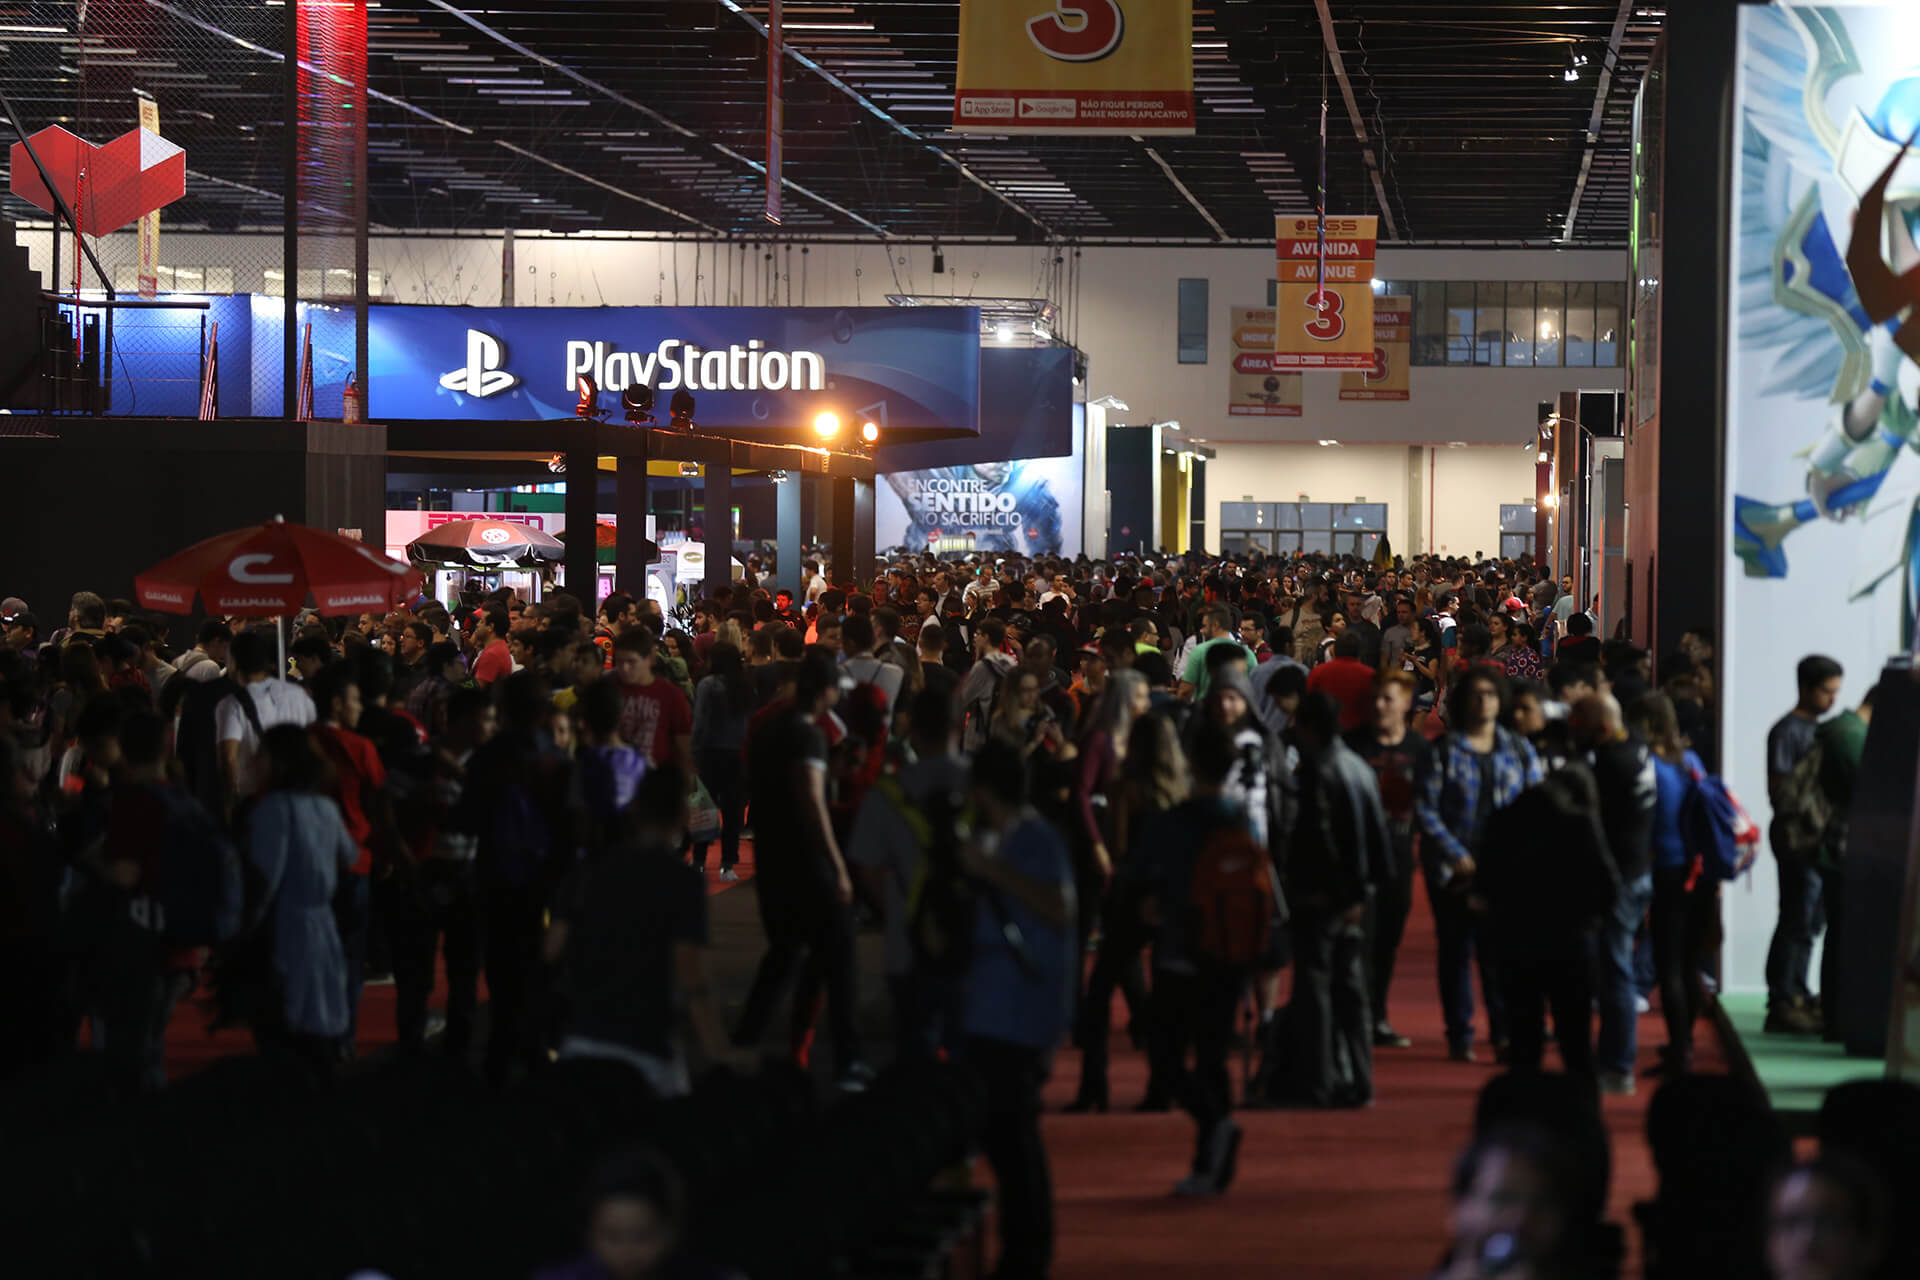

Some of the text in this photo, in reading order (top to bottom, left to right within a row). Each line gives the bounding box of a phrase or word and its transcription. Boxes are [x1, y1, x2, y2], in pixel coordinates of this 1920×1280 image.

[1295, 265, 1357, 279] AVNUE
[1304, 289, 1345, 341] 3
[566, 339, 826, 392] PlayStation
[909, 479, 988, 493] ENCONTRE
[908, 492, 1017, 513] SENTIDO
